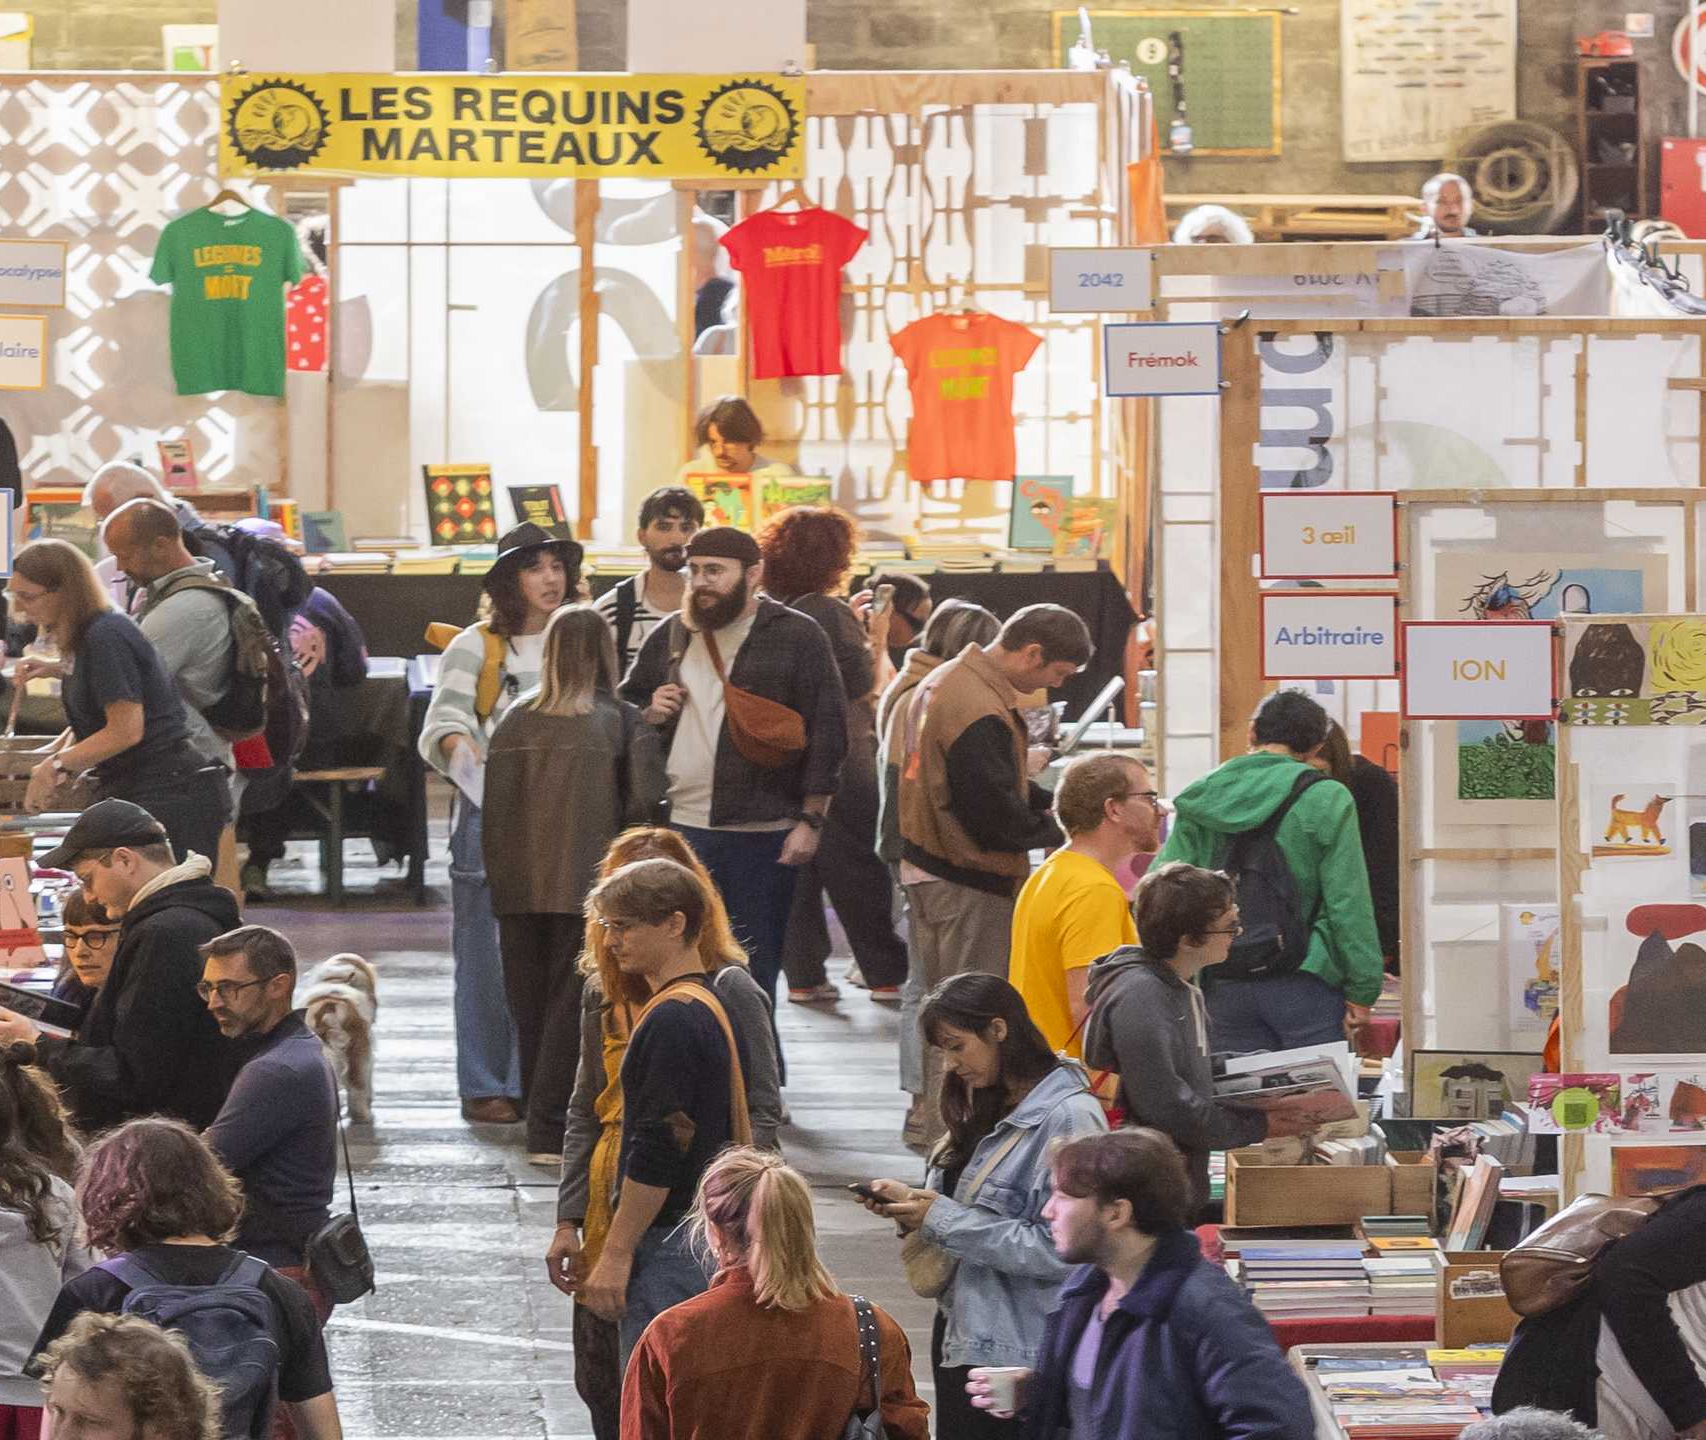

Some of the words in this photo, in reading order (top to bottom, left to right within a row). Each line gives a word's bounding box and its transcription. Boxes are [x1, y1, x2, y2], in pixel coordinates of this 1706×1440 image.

[340, 87, 434, 122] LES
[454, 86, 685, 128] REQUINS
[363, 128, 661, 167] MARTEAUX
[1078, 273, 1124, 288] 2042
[1129, 350, 1198, 368] Frémok
[1302, 525, 1316, 545] 3
[1321, 525, 1355, 545] œil
[1274, 626, 1385, 647] Arbitraire
[1452, 659, 1506, 682] ION
